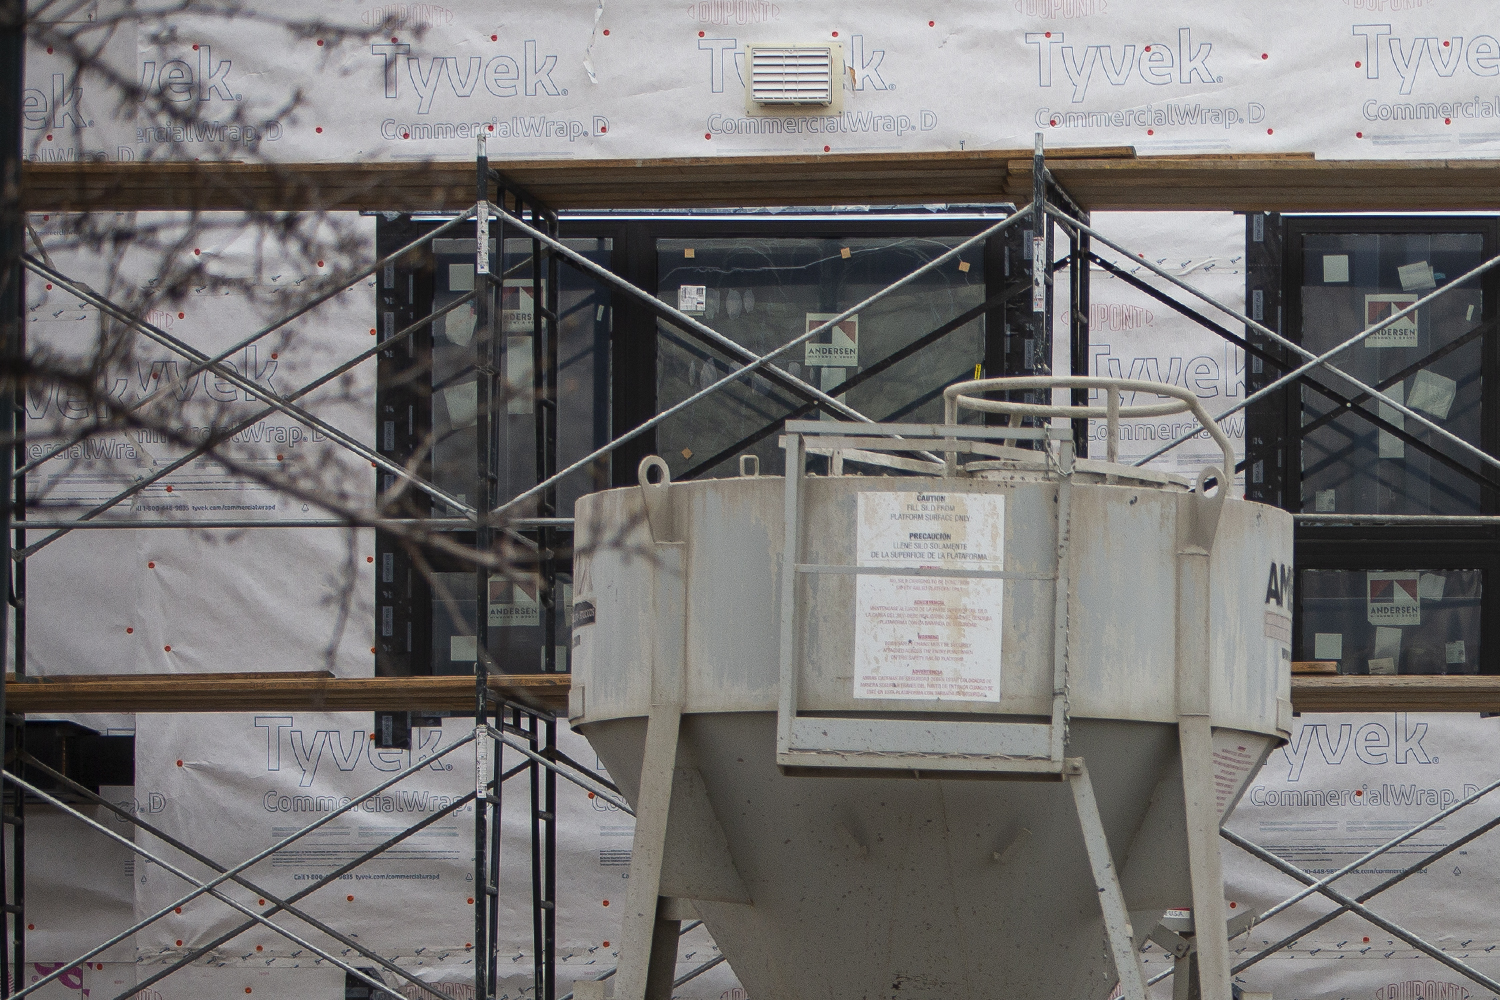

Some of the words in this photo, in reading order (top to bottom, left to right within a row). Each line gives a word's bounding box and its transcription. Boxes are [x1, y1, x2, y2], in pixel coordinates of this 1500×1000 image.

[1248, 102, 1265, 124] D
[920, 110, 938, 131] D
[808, 347, 856, 355] ANDERSEN
[1370, 606, 1418, 614] ANDERSEN
